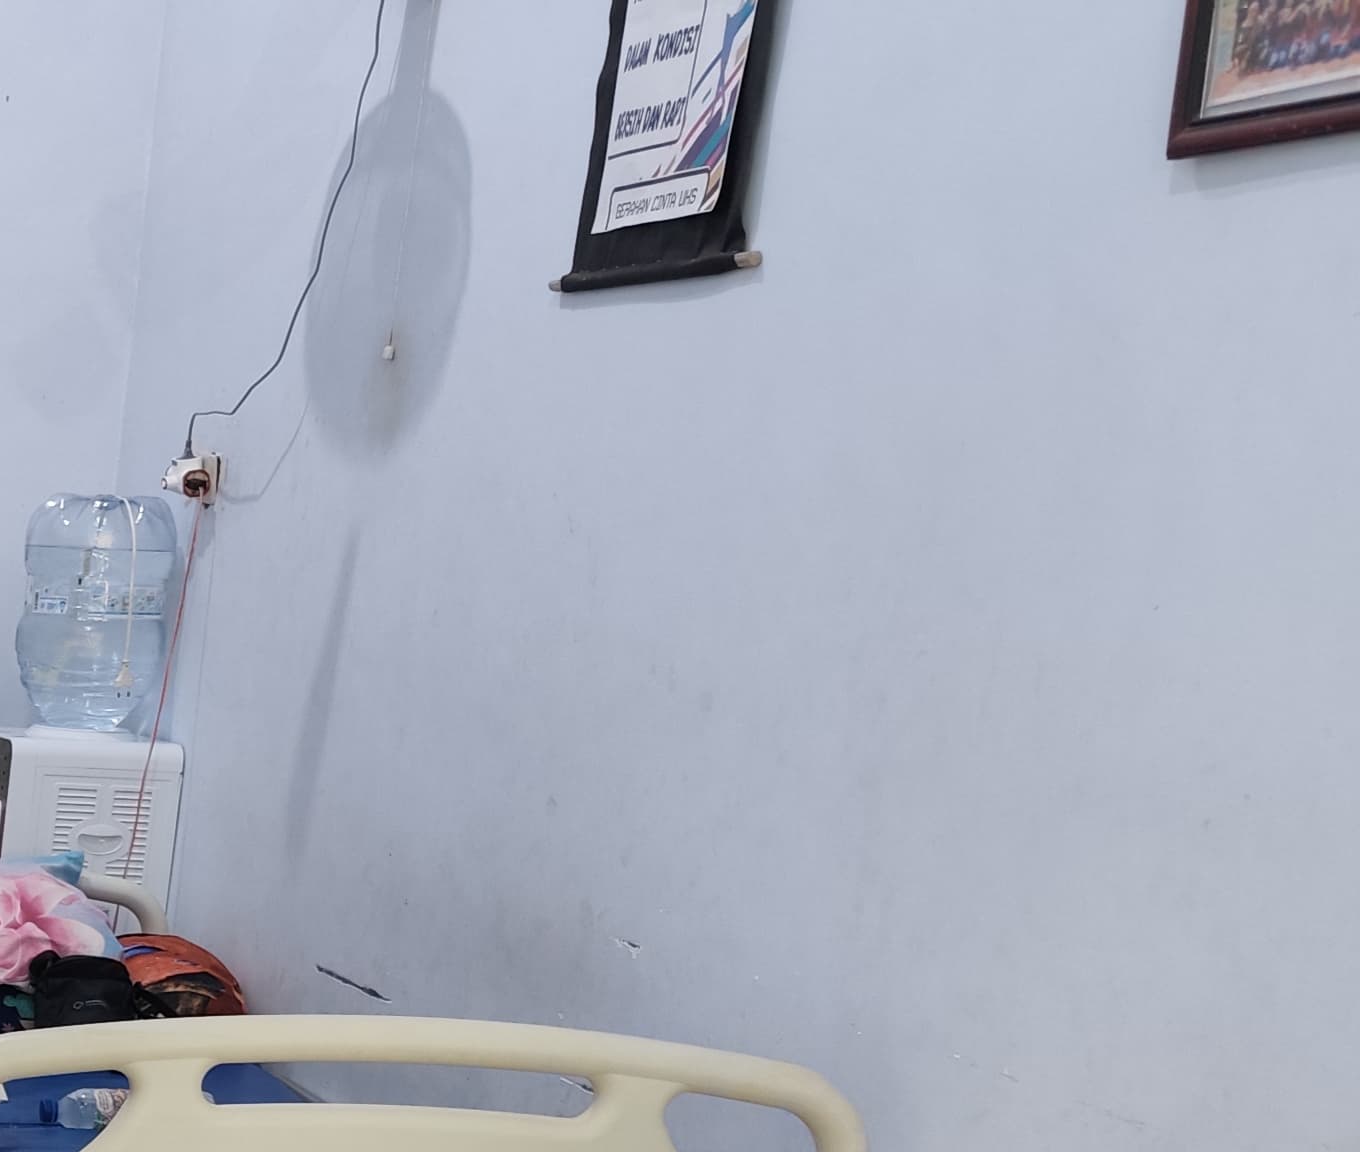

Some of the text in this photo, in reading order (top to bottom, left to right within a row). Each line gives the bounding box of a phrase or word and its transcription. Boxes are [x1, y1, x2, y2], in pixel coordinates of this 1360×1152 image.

[623, 24, 701, 73] DALAM KONDISI
[614, 96, 687, 142] BERSIH DAN RAPI
[650, 191, 677, 212] CINTA
